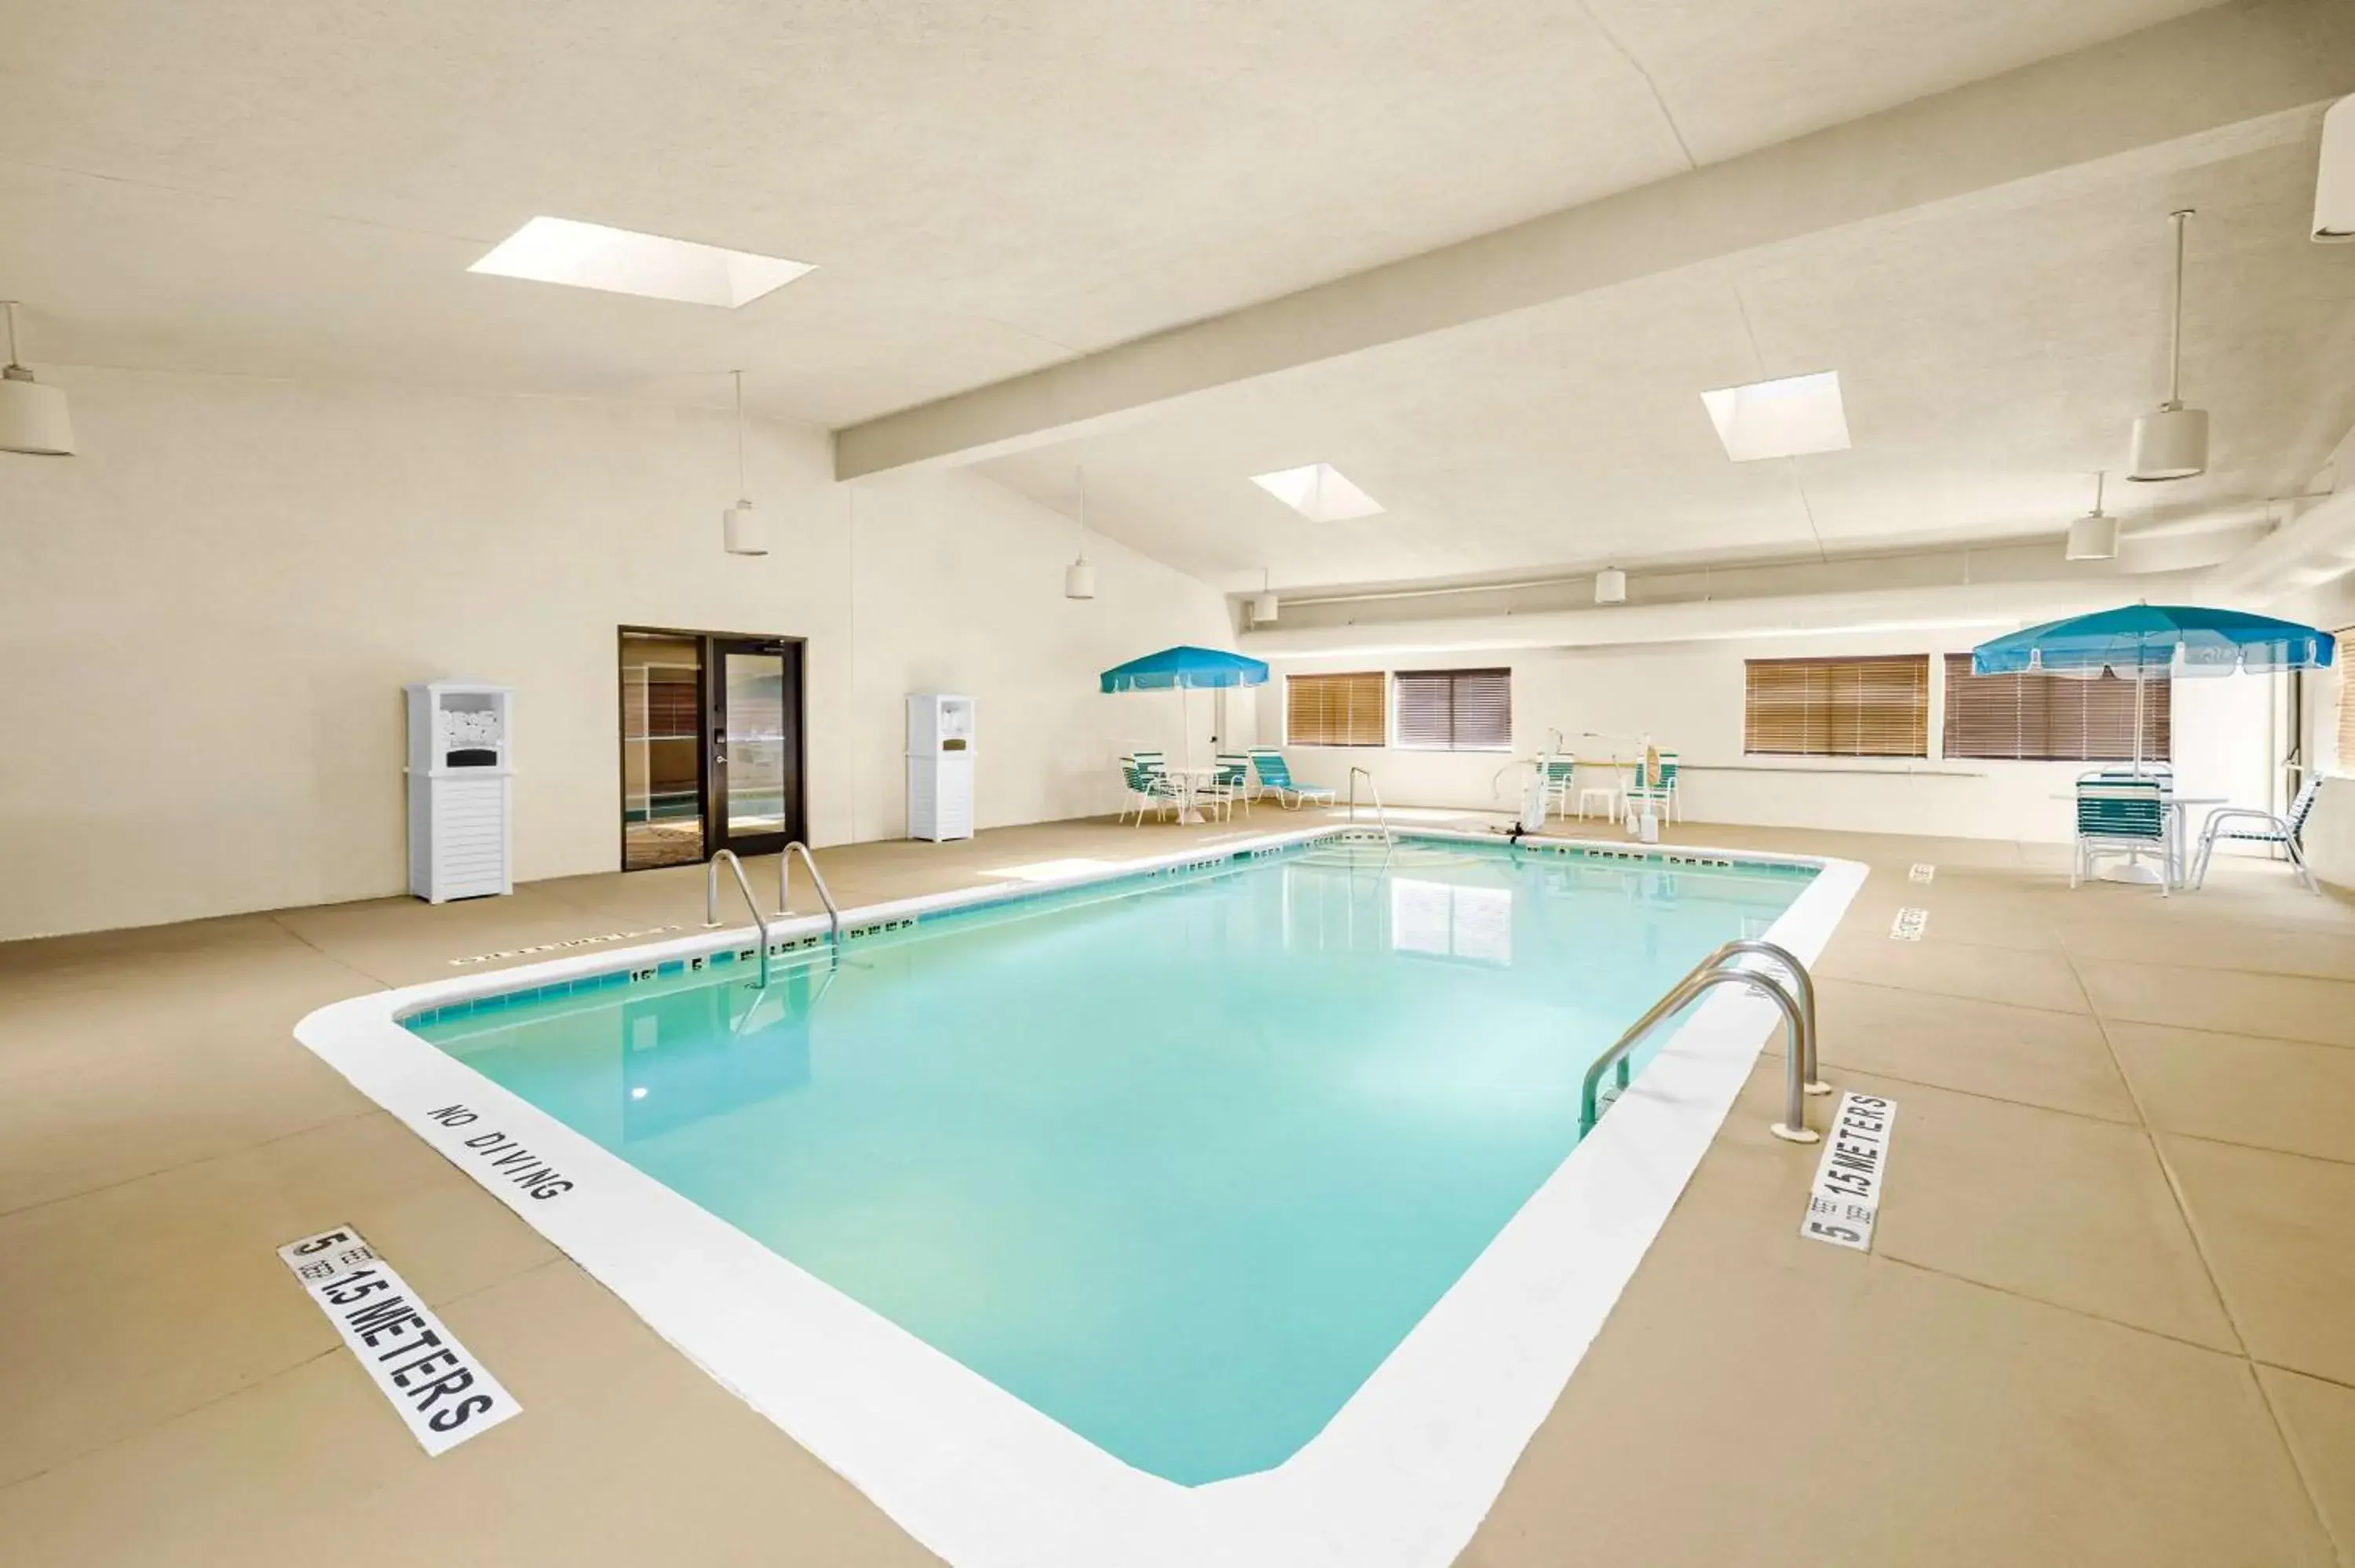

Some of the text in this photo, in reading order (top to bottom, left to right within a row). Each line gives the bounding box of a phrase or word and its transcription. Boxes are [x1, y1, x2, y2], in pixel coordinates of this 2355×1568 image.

[426, 1104, 574, 1200] NO DIVING
[1824, 1096, 1887, 1197] 1.5 METERS
[294, 1233, 349, 1256] 5
[1810, 1222, 1861, 1242] 5
[321, 1270, 493, 1432] 1.5 METERS
